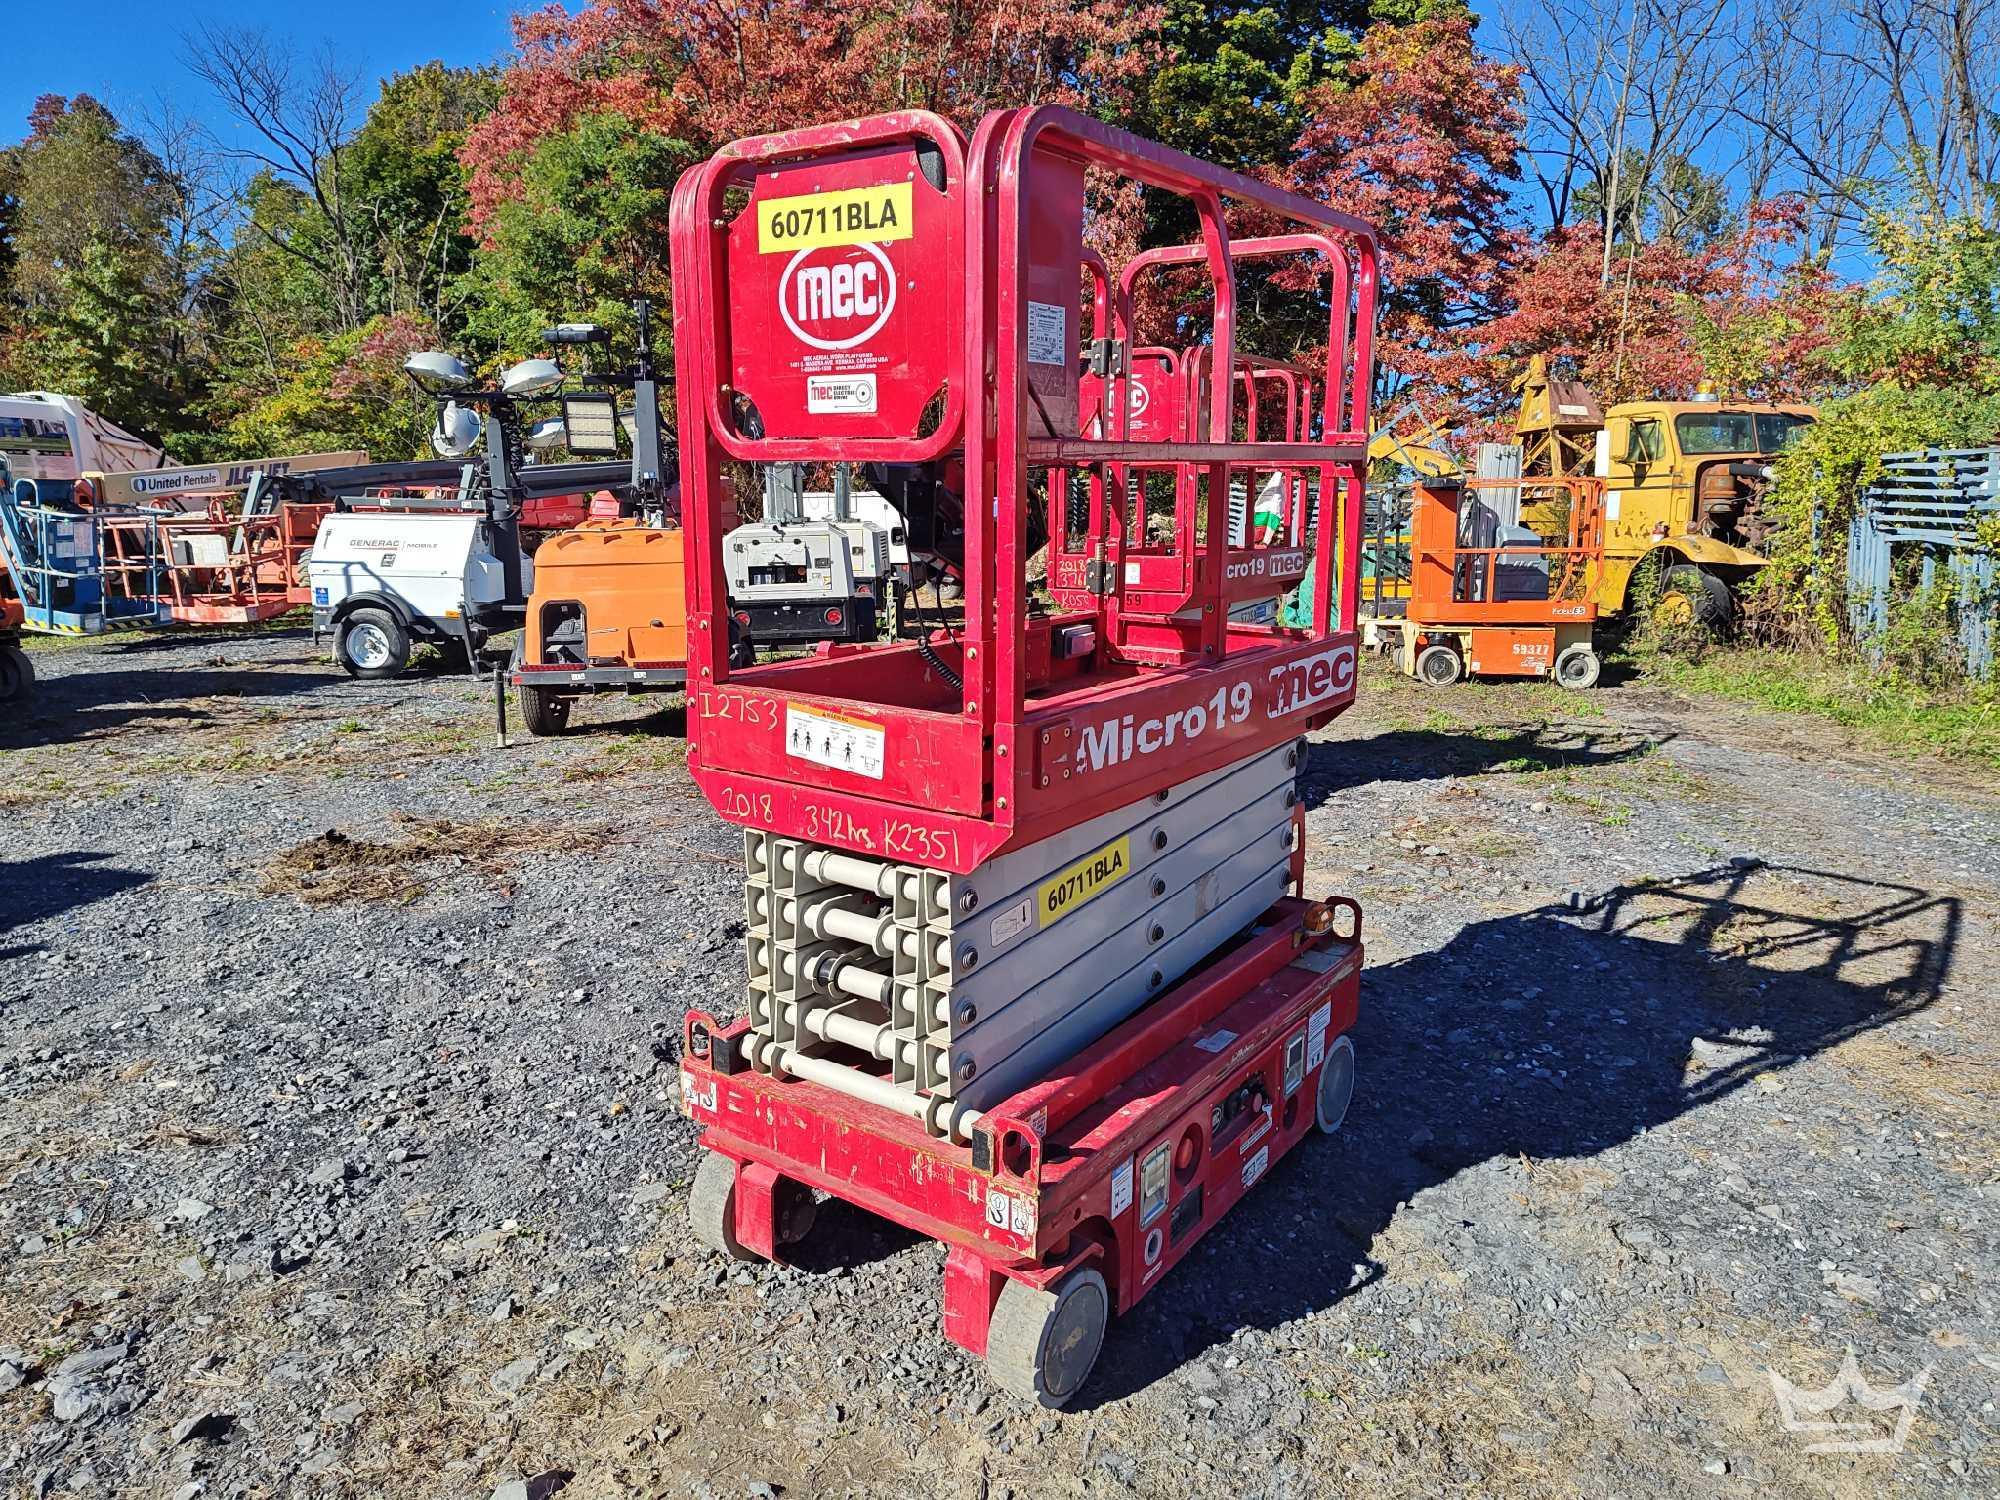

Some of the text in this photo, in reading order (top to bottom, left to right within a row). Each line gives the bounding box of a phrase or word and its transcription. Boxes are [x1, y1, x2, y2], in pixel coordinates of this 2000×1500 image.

[770, 198, 898, 239] 60711BLA
[148, 472, 217, 490] United Rentals
[349, 539, 400, 547] GENERAC
[1075, 681, 1253, 777] Micro19
[720, 787, 774, 824] 2018
[883, 817, 960, 867] K2351
[1046, 848, 1123, 914] 60711BLA
